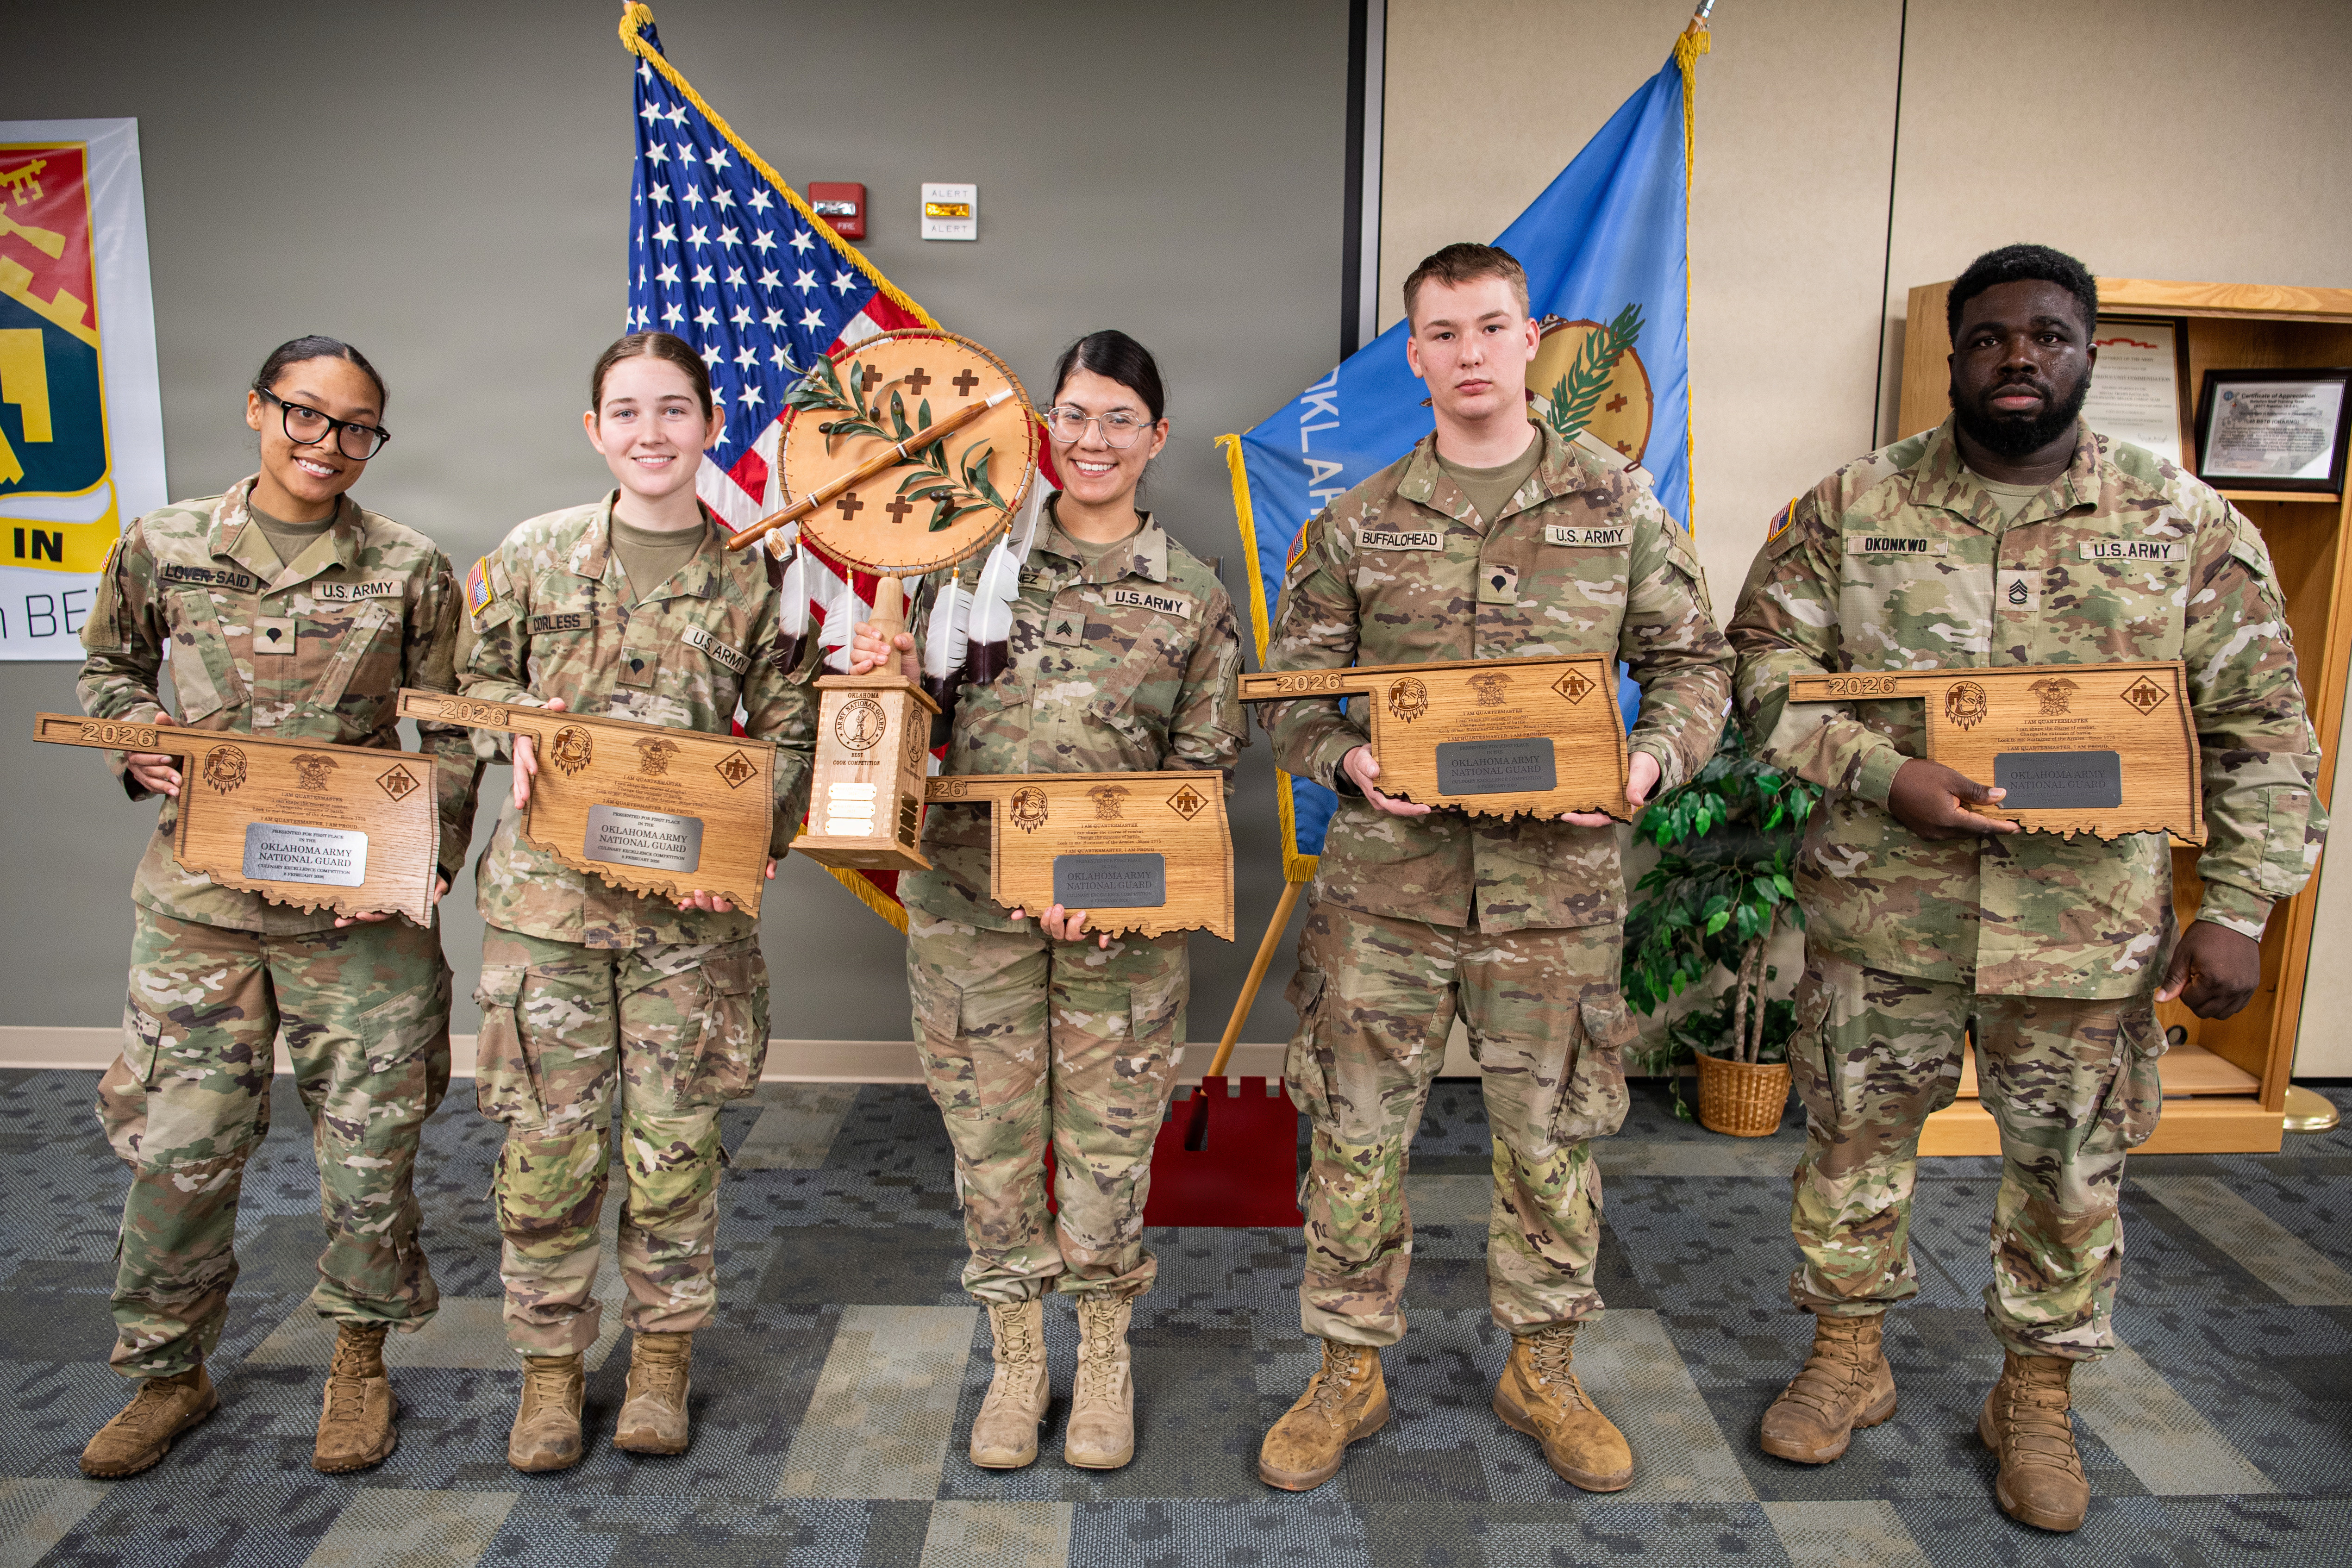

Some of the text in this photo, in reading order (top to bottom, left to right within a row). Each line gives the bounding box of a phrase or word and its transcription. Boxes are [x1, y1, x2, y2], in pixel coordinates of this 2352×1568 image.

[838, 222, 856, 231] FIRE
[1362, 532, 1437, 546] BUFFALOHEAD
[1556, 528, 1624, 543] U.S. ARMY
[13, 527, 63, 563] IN
[1865, 537, 1927, 553] OKONKWO
[2094, 543, 2171, 559] U.S. ARMY
[322, 581, 394, 598] U.S. ARMY
[1115, 591, 1183, 613] U.S. ARMY
[25, 587, 98, 638] BE
[533, 613, 581, 632] CORLESS
[693, 631, 746, 671] U.S. ARMY
[1276, 673, 1343, 693] 2026
[1828, 675, 1897, 696] 2026
[438, 700, 509, 726] 2026
[837, 711, 846, 731] ARMY
[845, 701, 876, 712] NATIONAL
[876, 709, 884, 731] GUARD
[81, 721, 157, 748] 2026
[1451, 756, 1540, 767] OKLAHOMA ARMY
[1451, 765, 1541, 776] NATIONAL GUARD
[2010, 771, 2072, 779] OKLAHOMA
[294, 793, 343, 802] QUARTERMASTER
[925, 780, 965, 798] 026
[601, 824, 688, 843] OKLAHOMA ARMY
[261, 842, 352, 857] OKLAHOMA ARMY
[599, 834, 686, 853] NATIONAL GUARD
[259, 852, 351, 867] NATIONAL GUARD
